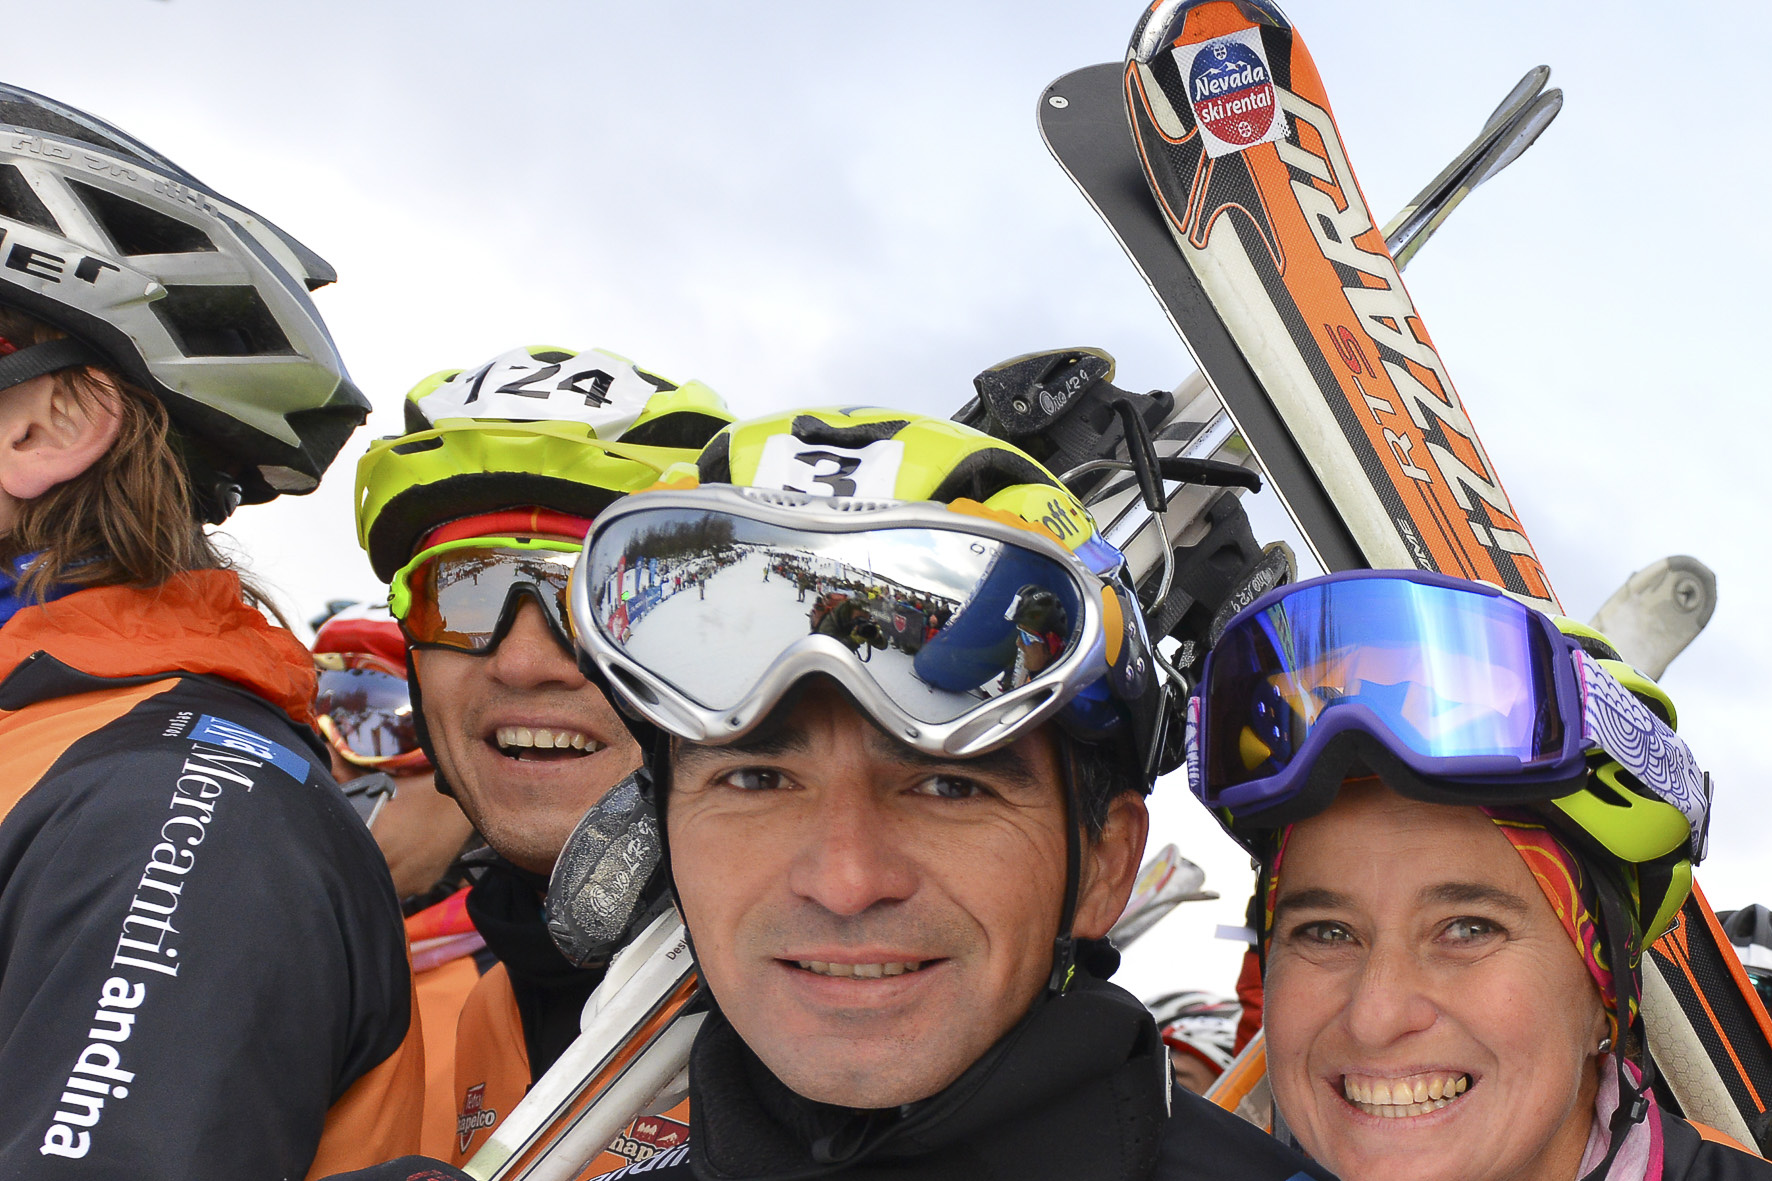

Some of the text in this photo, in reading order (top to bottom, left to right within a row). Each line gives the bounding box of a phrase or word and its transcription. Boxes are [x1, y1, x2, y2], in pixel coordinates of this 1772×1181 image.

[1195, 65, 1265, 101] Nevada
[1202, 86, 1271, 123] ski rental
[464, 361, 615, 408] 124
[1324, 322, 1434, 484] RTS
[783, 450, 862, 497] 3
[162, 711, 194, 737] seguros
[39, 742, 263, 1160] Mercantil andina
